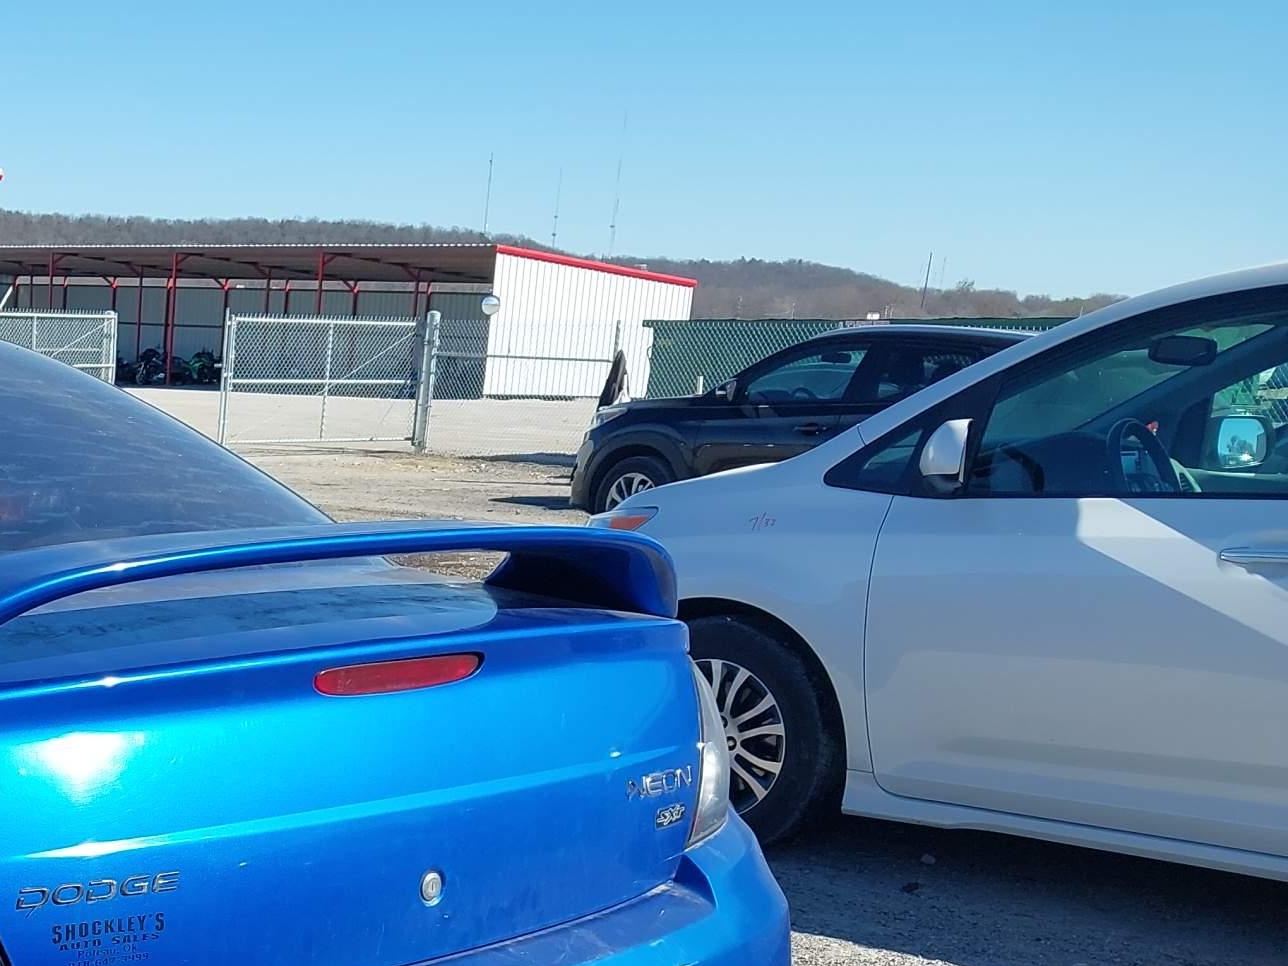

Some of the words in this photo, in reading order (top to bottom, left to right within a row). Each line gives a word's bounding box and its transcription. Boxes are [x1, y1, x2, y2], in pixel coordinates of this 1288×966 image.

[626, 765, 692, 802] NEON
[16, 871, 180, 911] DODGE
[52, 912, 165, 945] SHOCKLEY'S
[59, 938, 102, 952] AUTO
[112, 932, 161, 945] SALES
